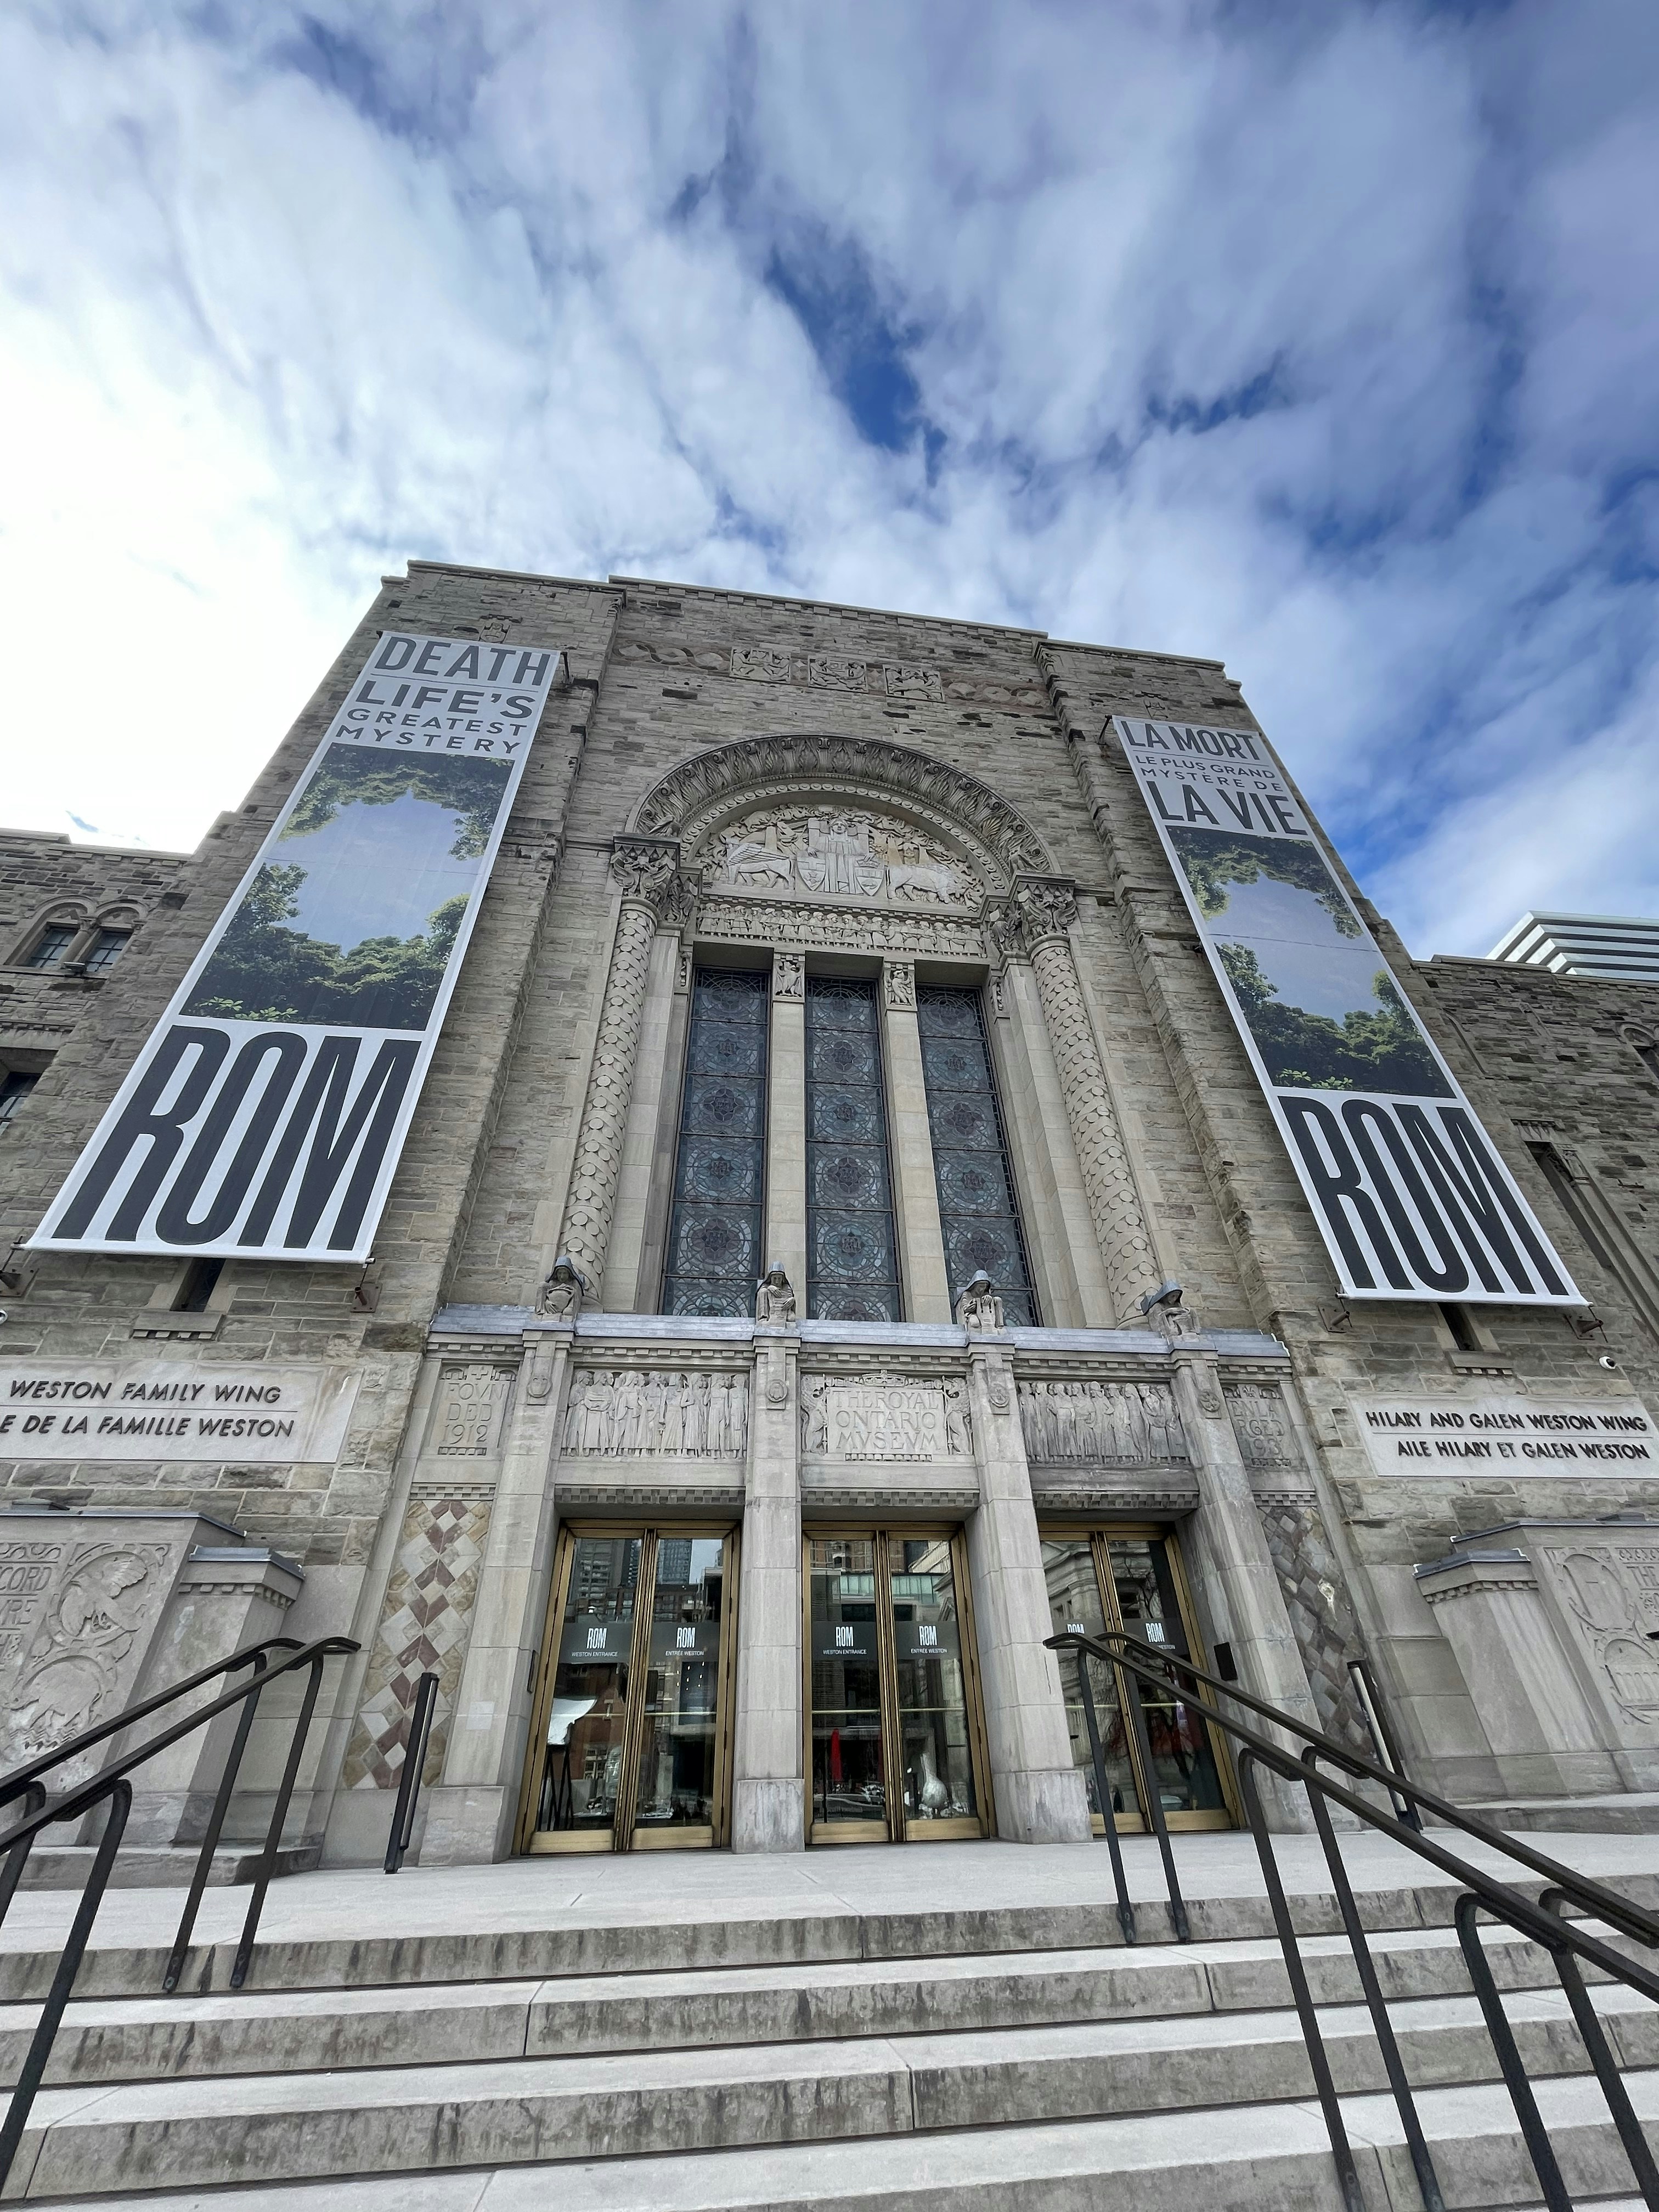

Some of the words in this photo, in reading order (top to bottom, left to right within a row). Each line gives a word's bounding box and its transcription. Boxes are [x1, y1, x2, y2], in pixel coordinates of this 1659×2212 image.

[374, 636, 551, 686] DEATH
[356, 680, 535, 718] LIFE'S
[347, 708, 527, 736] GREATEST
[335, 725, 522, 754] MYSTERY
[1121, 720, 1170, 749] LA
[1169, 726, 1260, 760] MORT
[1135, 755, 1156, 764] LE
[1161, 758, 1206, 770] PLUS
[1210, 764, 1275, 778] GRAND
[1140, 768, 1245, 788] MYSTÈRE
[1254, 781, 1283, 792] DE
[1147, 781, 1220, 825] LA
[1216, 788, 1308, 836] VIE
[51, 1025, 422, 1251] ROM
[1277, 1095, 1569, 1296] ROM
[10, 1380, 111, 1399] WESTON
[120, 1383, 205, 1401] FAMILY
[215, 1385, 281, 1403] WING
[22, 1415, 56, 1434] DE
[61, 1415, 89, 1434] LA
[97, 1417, 191, 1436] FAMILLE
[199, 1418, 295, 1437] WESTON
[834, 1410, 936, 1430] ONTARIO
[1365, 1412, 1422, 1427] HILARY
[1430, 1413, 1464, 1428] AND
[1470, 1413, 1524, 1429] GALEN
[1528, 1414, 1596, 1430] WESTON
[1597, 1415, 1647, 1431] WING
[443, 1424, 488, 1444] 1912
[1398, 1441, 1431, 1457] AILE
[1435, 1442, 1492, 1457] HILARY
[1497, 1442, 1516, 1457] ET
[1522, 1443, 1578, 1458] GALEN
[1580, 1443, 1651, 1459] WESTON
[586, 1628, 607, 1649] ROM
[676, 1627, 696, 1648] ROM
[836, 1626, 854, 1647] ROM
[919, 1626, 938, 1646] ROM
[1145, 1622, 1165, 1643] ROM
